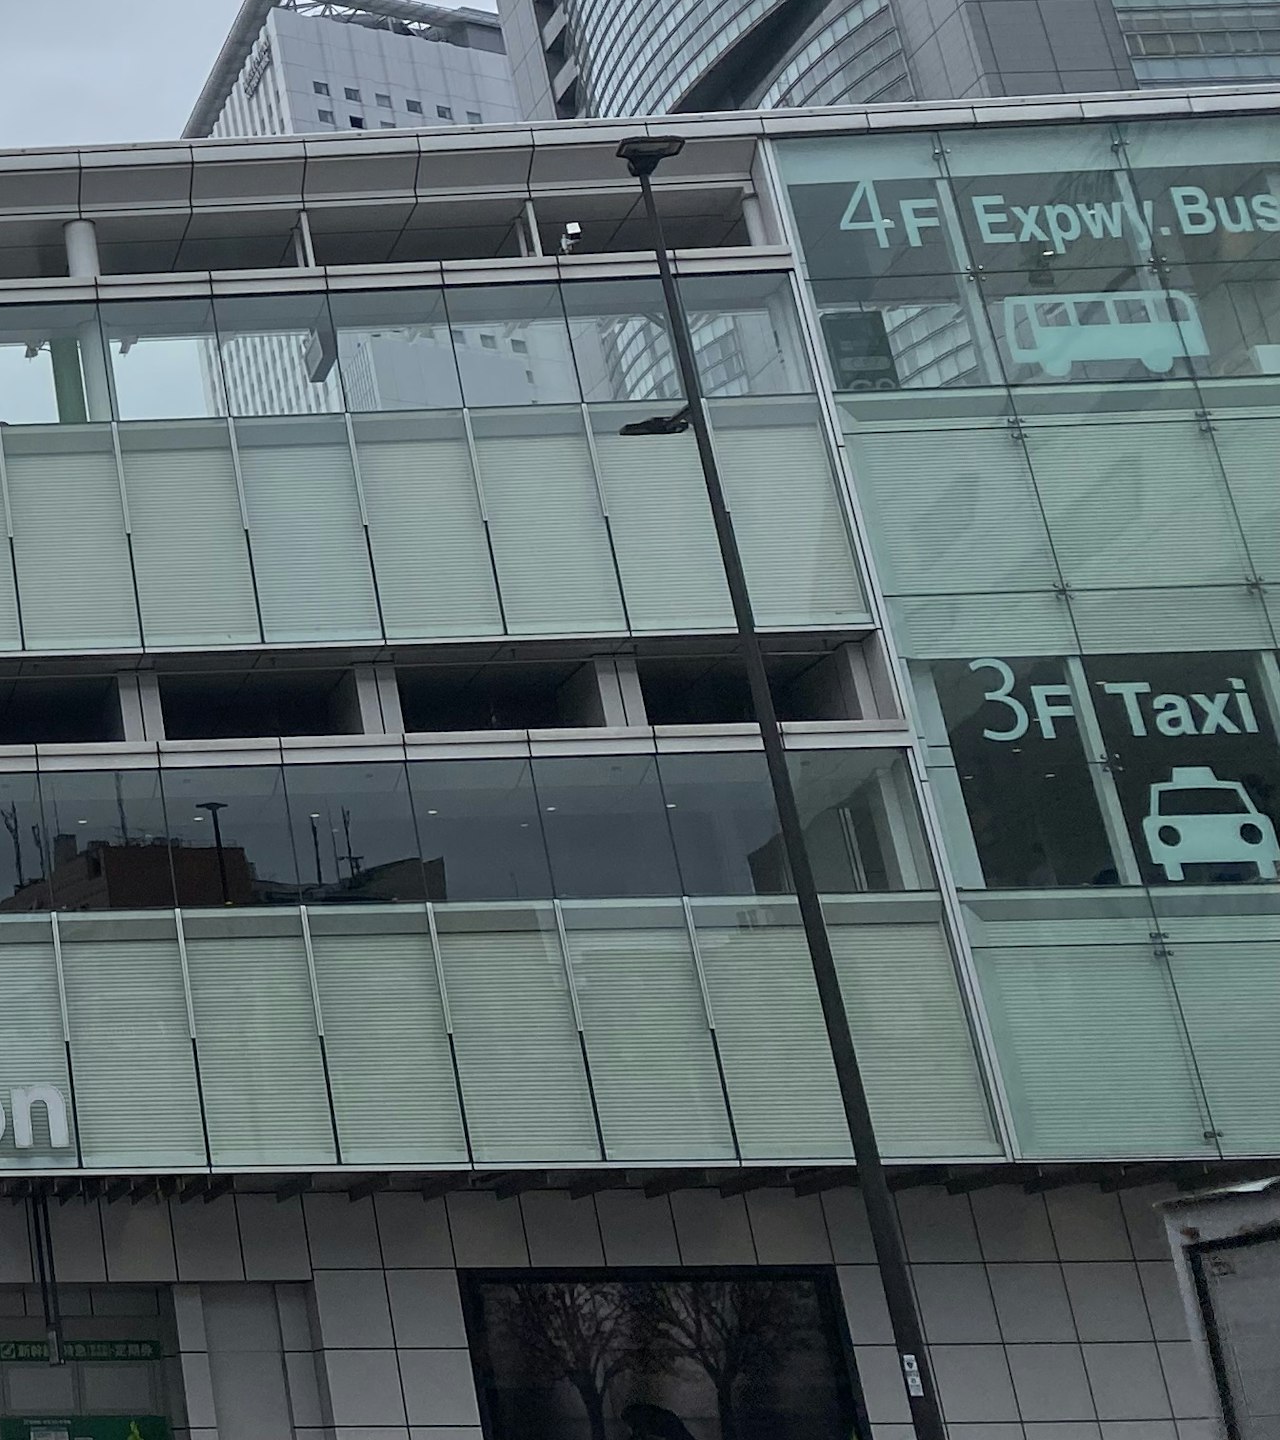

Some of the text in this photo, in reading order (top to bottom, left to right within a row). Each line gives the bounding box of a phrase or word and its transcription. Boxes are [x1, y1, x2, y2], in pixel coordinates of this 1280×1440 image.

[840, 179, 940, 248] 4F
[1170, 186, 1280, 236] Bus
[969, 658, 1259, 741] 3F Taxi
